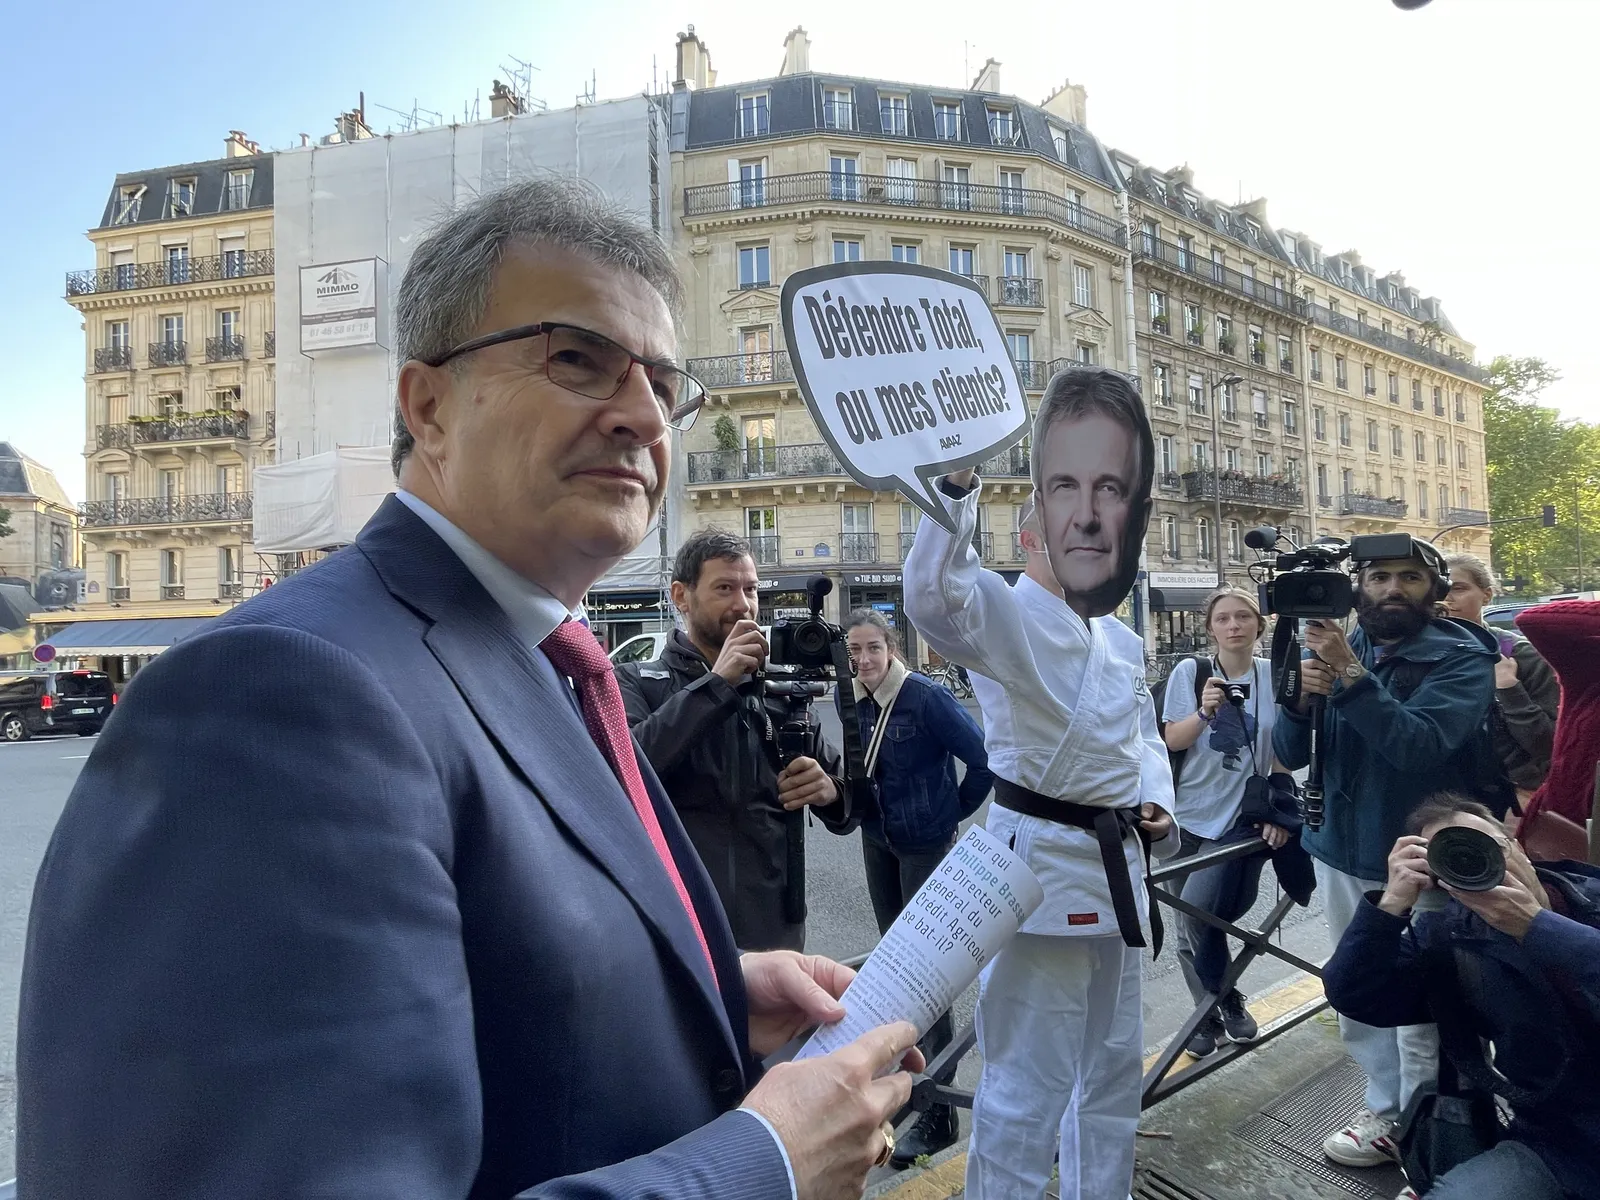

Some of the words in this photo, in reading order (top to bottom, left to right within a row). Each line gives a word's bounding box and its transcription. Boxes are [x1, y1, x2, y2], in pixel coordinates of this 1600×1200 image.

[317, 283, 359, 295] MIMMO
[802, 289, 926, 360] Défendre
[919, 298, 985, 353] Total,
[836, 390, 883, 445] ou
[874, 380, 937, 435] mes
[932, 363, 1011, 424] clients?
[939, 434, 962, 451] AVAAZ
[758, 579, 773, 588] SHOP
[861, 575, 871, 583] THE
[872, 575, 881, 583] BIO
[882, 575, 896, 583] SHOP
[1285, 670, 1297, 697] Canon
[965, 831, 992, 855] Pour
[991, 853, 1012, 871] qui
[925, 879, 970, 913] général
[966, 908, 985, 928] du
[940, 860, 953, 875] le
[952, 869, 1003, 918] Directeur
[953, 846, 998, 887] Philippe
[997, 882, 1025, 925] Brassa
[902, 910, 916, 924] se
[914, 917, 954, 955] bat-il?
[915, 891, 948, 923] Crédit
[946, 917, 985, 965] Agricole
[880, 958, 899, 975] grandes
[898, 973, 927, 1004] entreprises
[892, 958, 902, 968] des
[901, 965, 925, 989] milliards
[862, 999, 889, 1025] notammen
